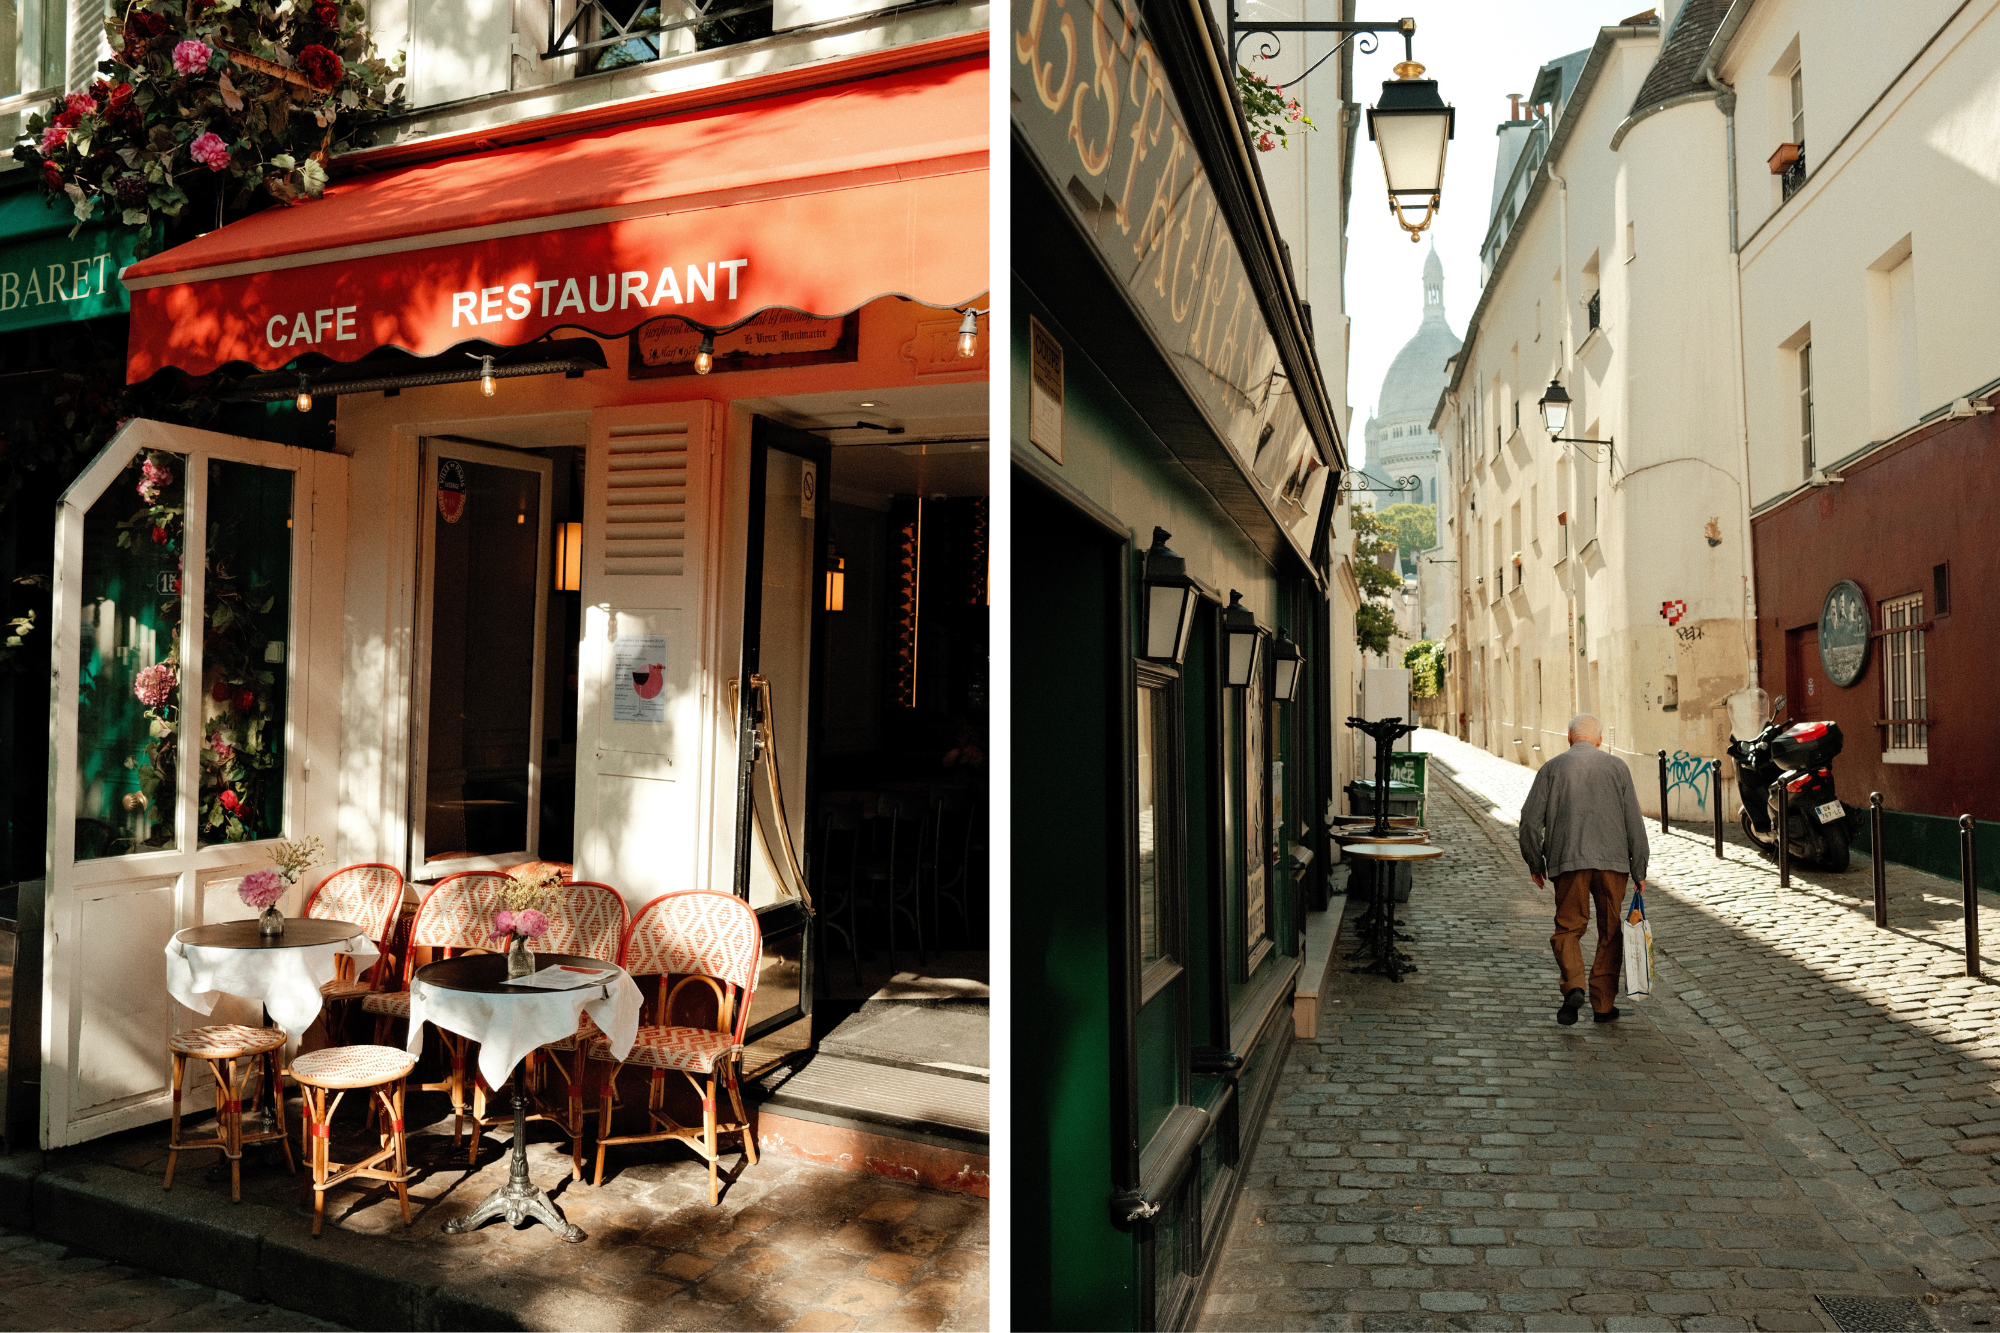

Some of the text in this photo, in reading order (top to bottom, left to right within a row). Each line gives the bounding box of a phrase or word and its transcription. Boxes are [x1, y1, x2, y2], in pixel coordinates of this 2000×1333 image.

[0, 252, 111, 311] BARET
[452, 258, 748, 327] RESTAURANT
[266, 305, 357, 347] CAFE
[780, 329, 827, 341] Montmartre
